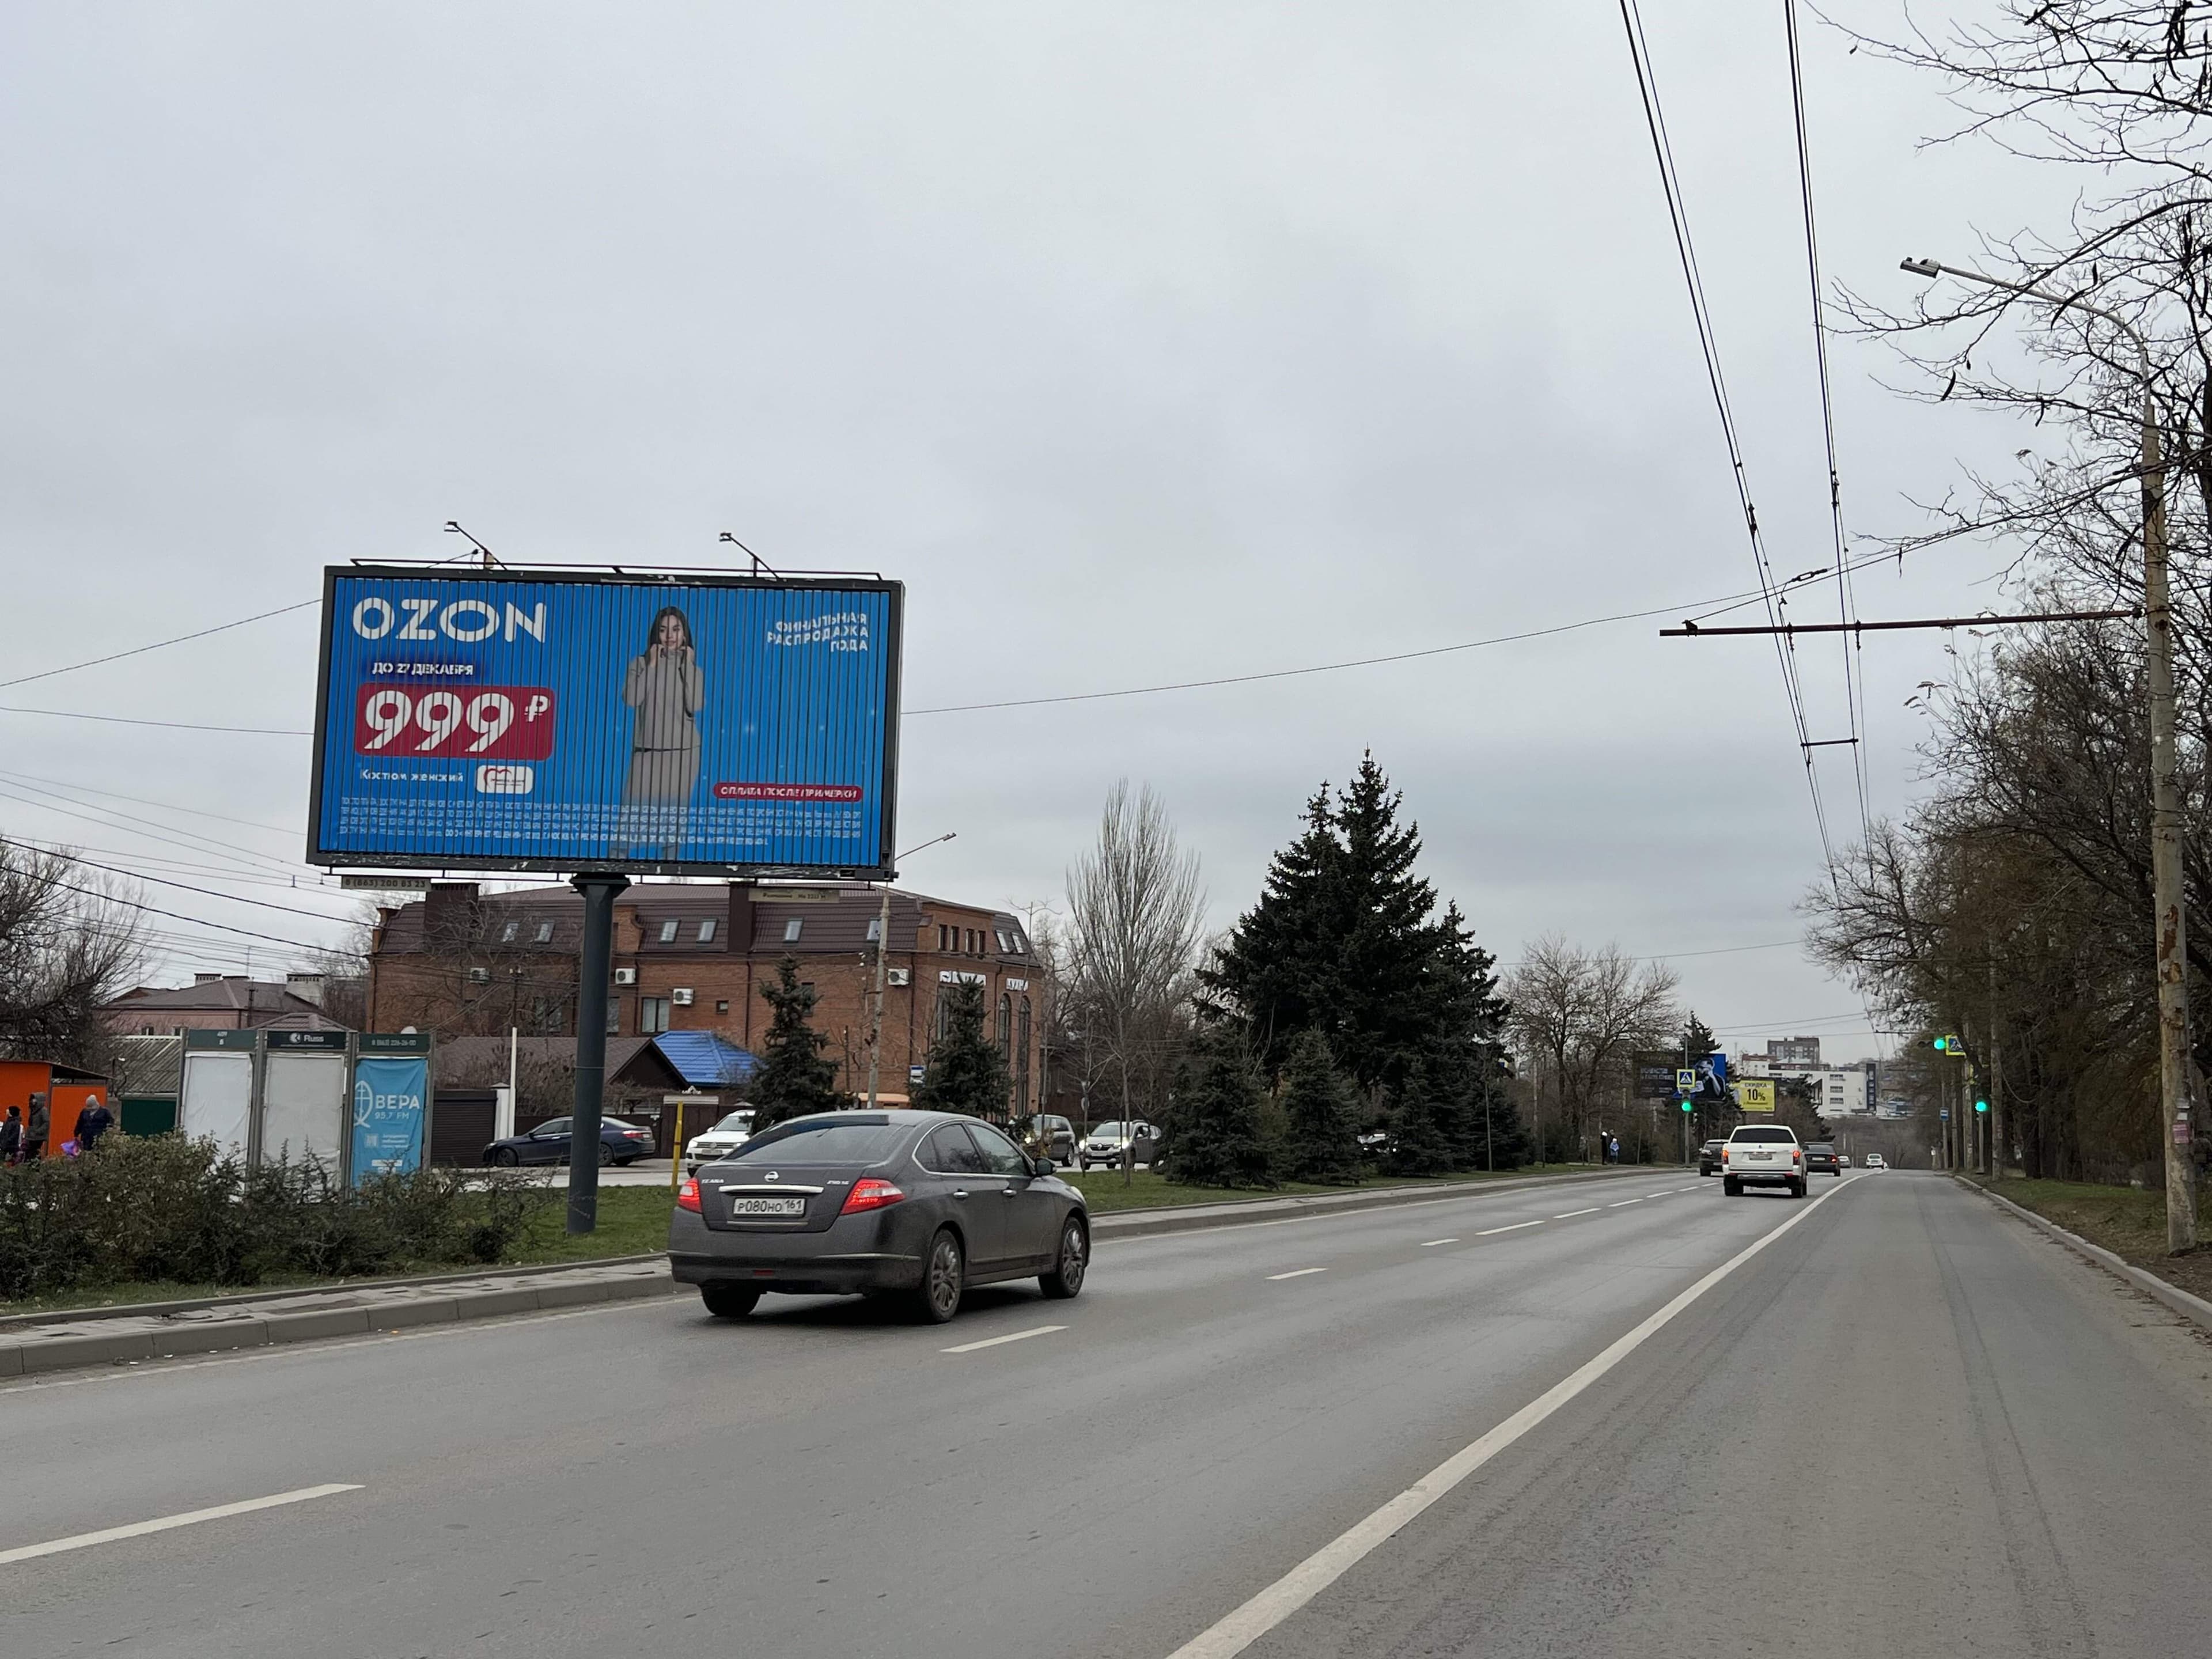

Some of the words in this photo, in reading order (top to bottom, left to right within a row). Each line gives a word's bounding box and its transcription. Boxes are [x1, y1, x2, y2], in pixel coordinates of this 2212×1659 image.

[352, 597, 547, 643] OZON
[775, 611, 867, 633] ФИНАЛЬНАЯ
[767, 626, 869, 646] РАСПРОДАЖА
[830, 639, 868, 653] ГОДА
[372, 662, 394, 675] ДО
[397, 663, 411, 674] 27
[411, 663, 474, 676] ДЕКАБРЯ
[363, 690, 516, 753] 999
[361, 768, 408, 781] Костюм
[410, 771, 464, 782] женский
[720, 786, 762, 797] ОПЛАТА
[763, 787, 800, 797] ПОСЛЕ
[800, 788, 857, 799] ПРИМЕРКИ
[1747, 1088, 1766, 1101] 10%
[375, 1095, 421, 1109] ВЕРА
[785, 1199, 802, 1209] 161
